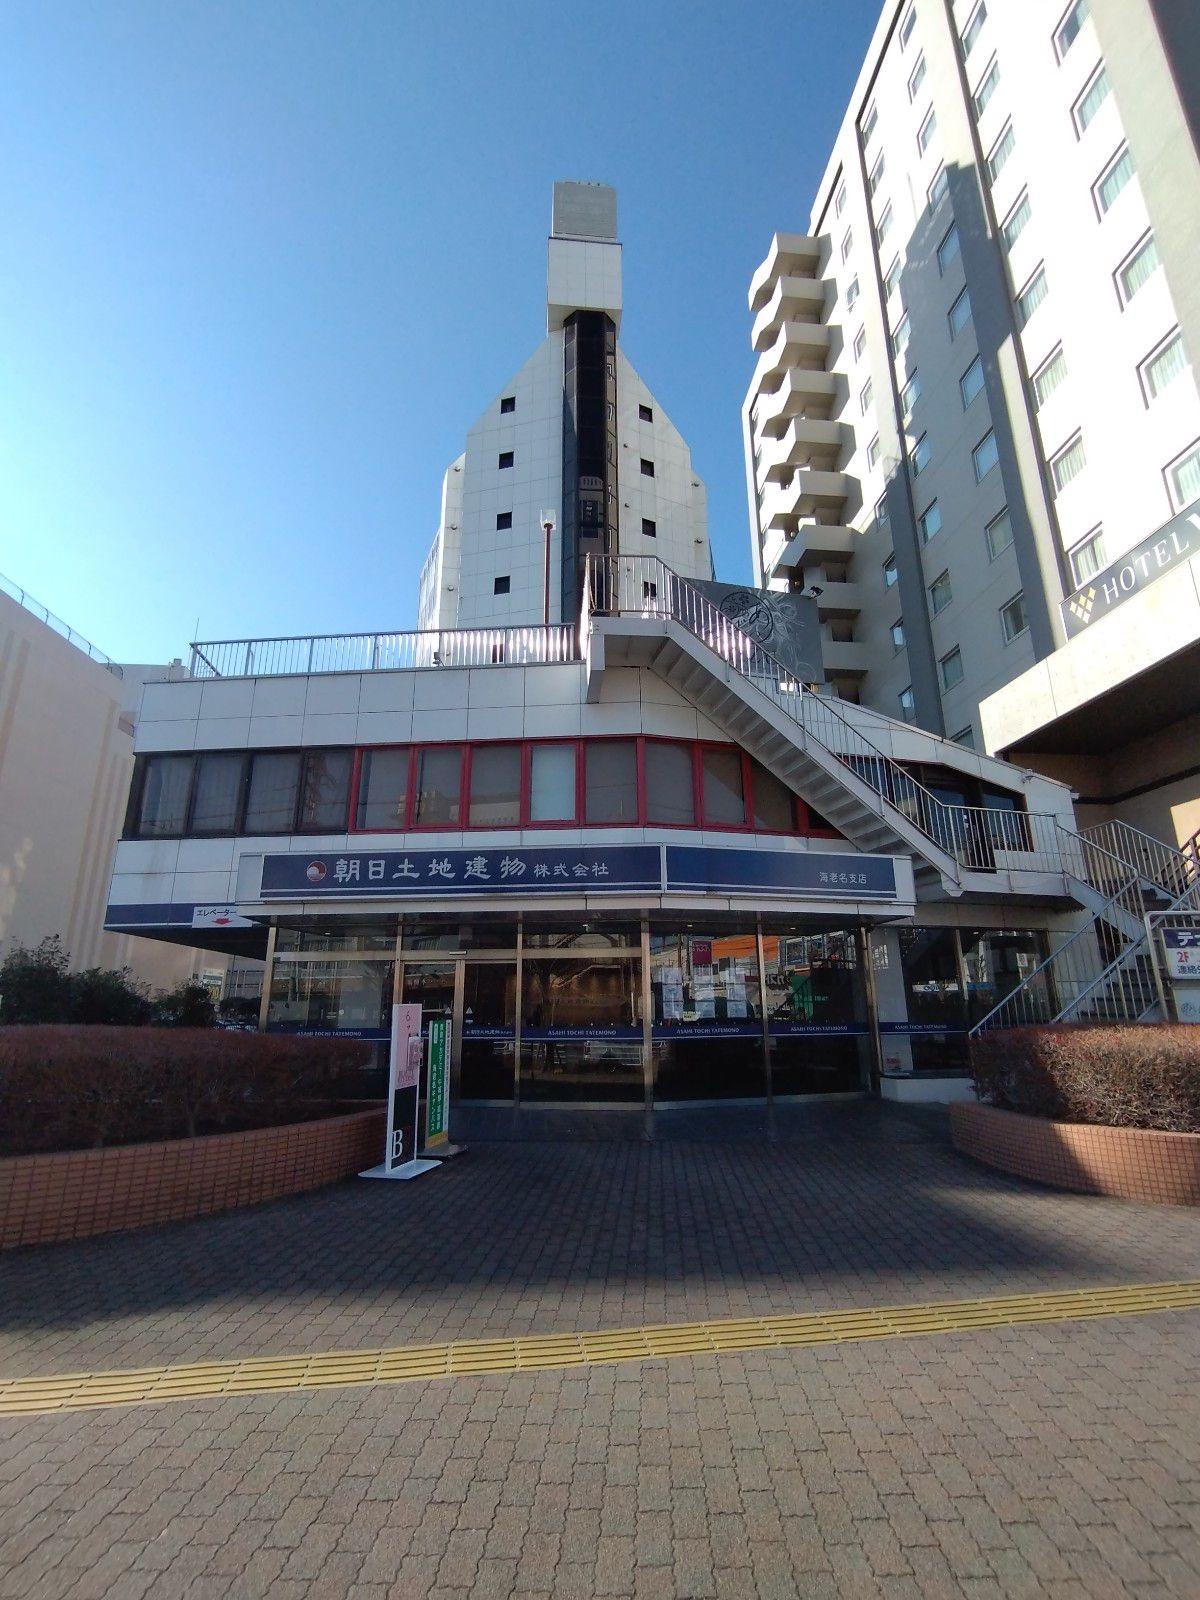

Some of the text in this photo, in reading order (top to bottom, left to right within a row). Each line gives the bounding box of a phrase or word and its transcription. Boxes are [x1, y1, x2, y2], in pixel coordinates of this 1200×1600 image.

[1102, 531, 1190, 605] HOTEL
[819, 871, 867, 884] 海老名支店
[196, 908, 237, 917] エレベーター
[1177, 951, 1189, 963] 2F
